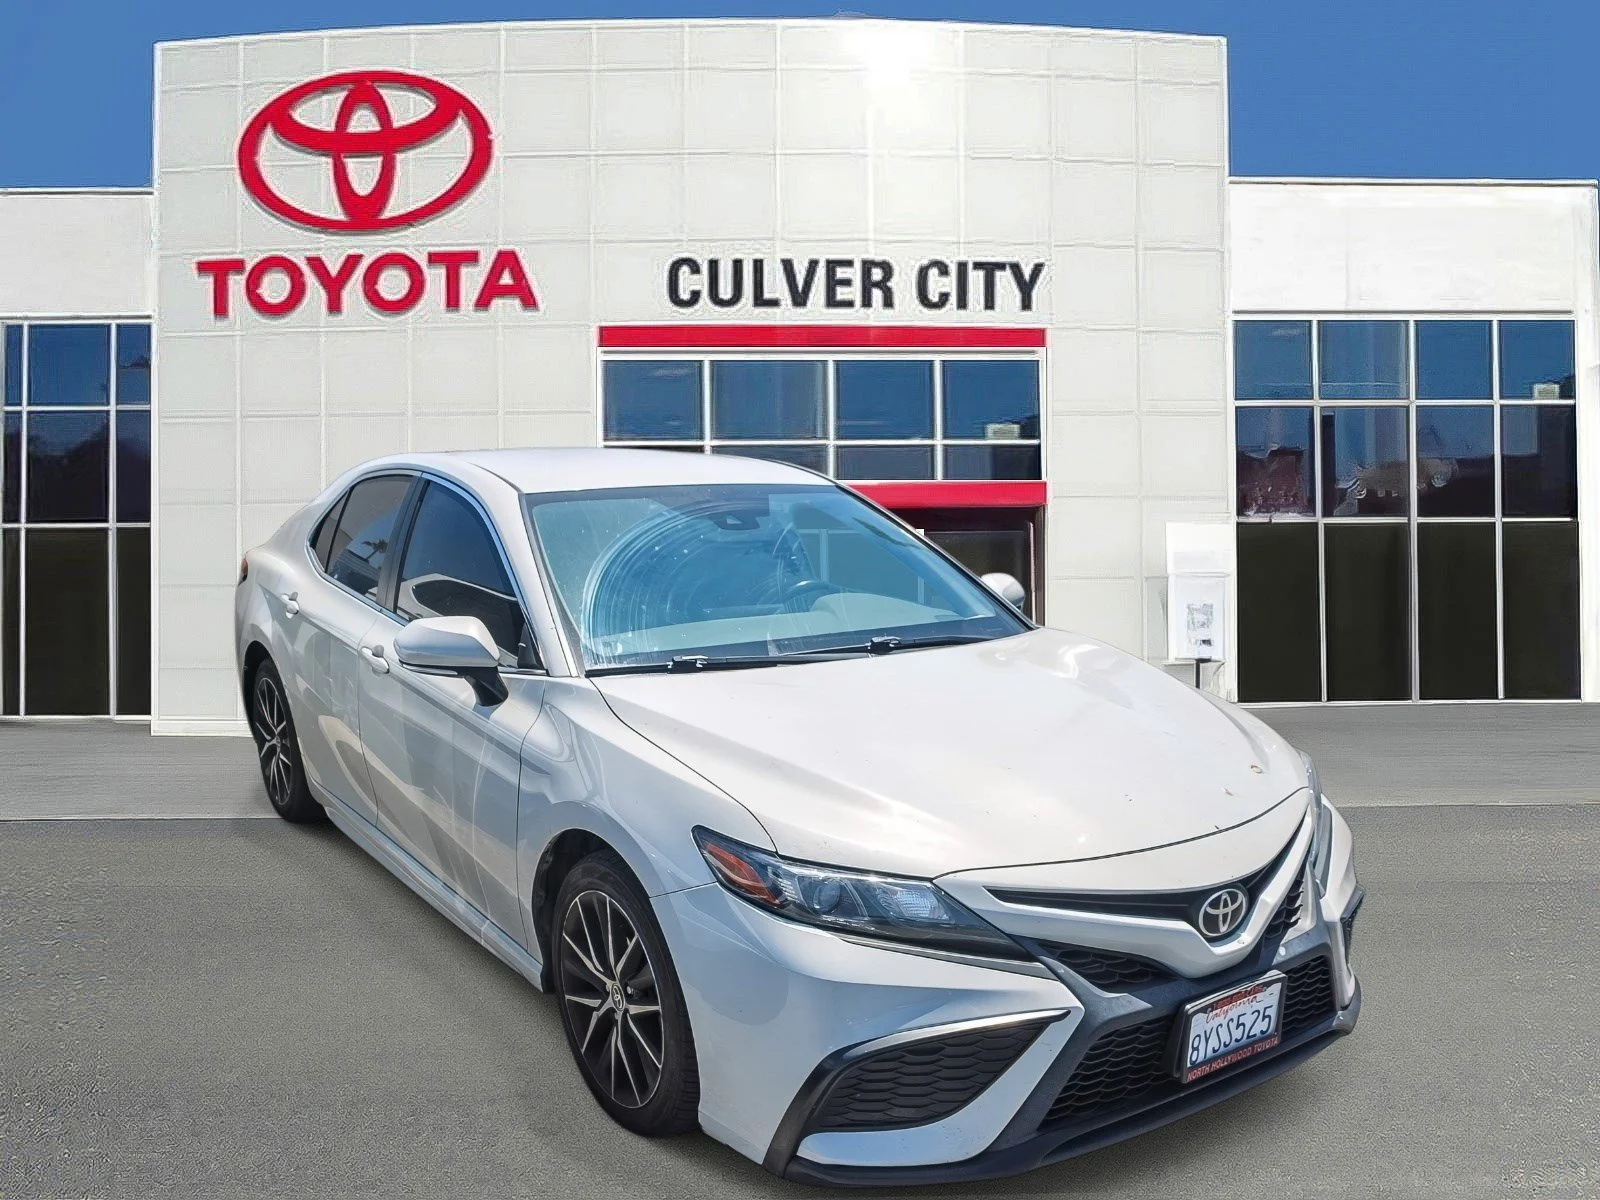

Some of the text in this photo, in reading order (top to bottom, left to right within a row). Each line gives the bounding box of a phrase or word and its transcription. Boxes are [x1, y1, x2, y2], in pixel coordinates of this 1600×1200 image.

[196, 249, 540, 318] TOYOTA
[667, 257, 1046, 310] CULVER CITY
[1187, 1037, 1279, 1081] NORTH HOLLYWOOD TOYOTA
[1189, 1005, 1273, 1066] 8YSS525
